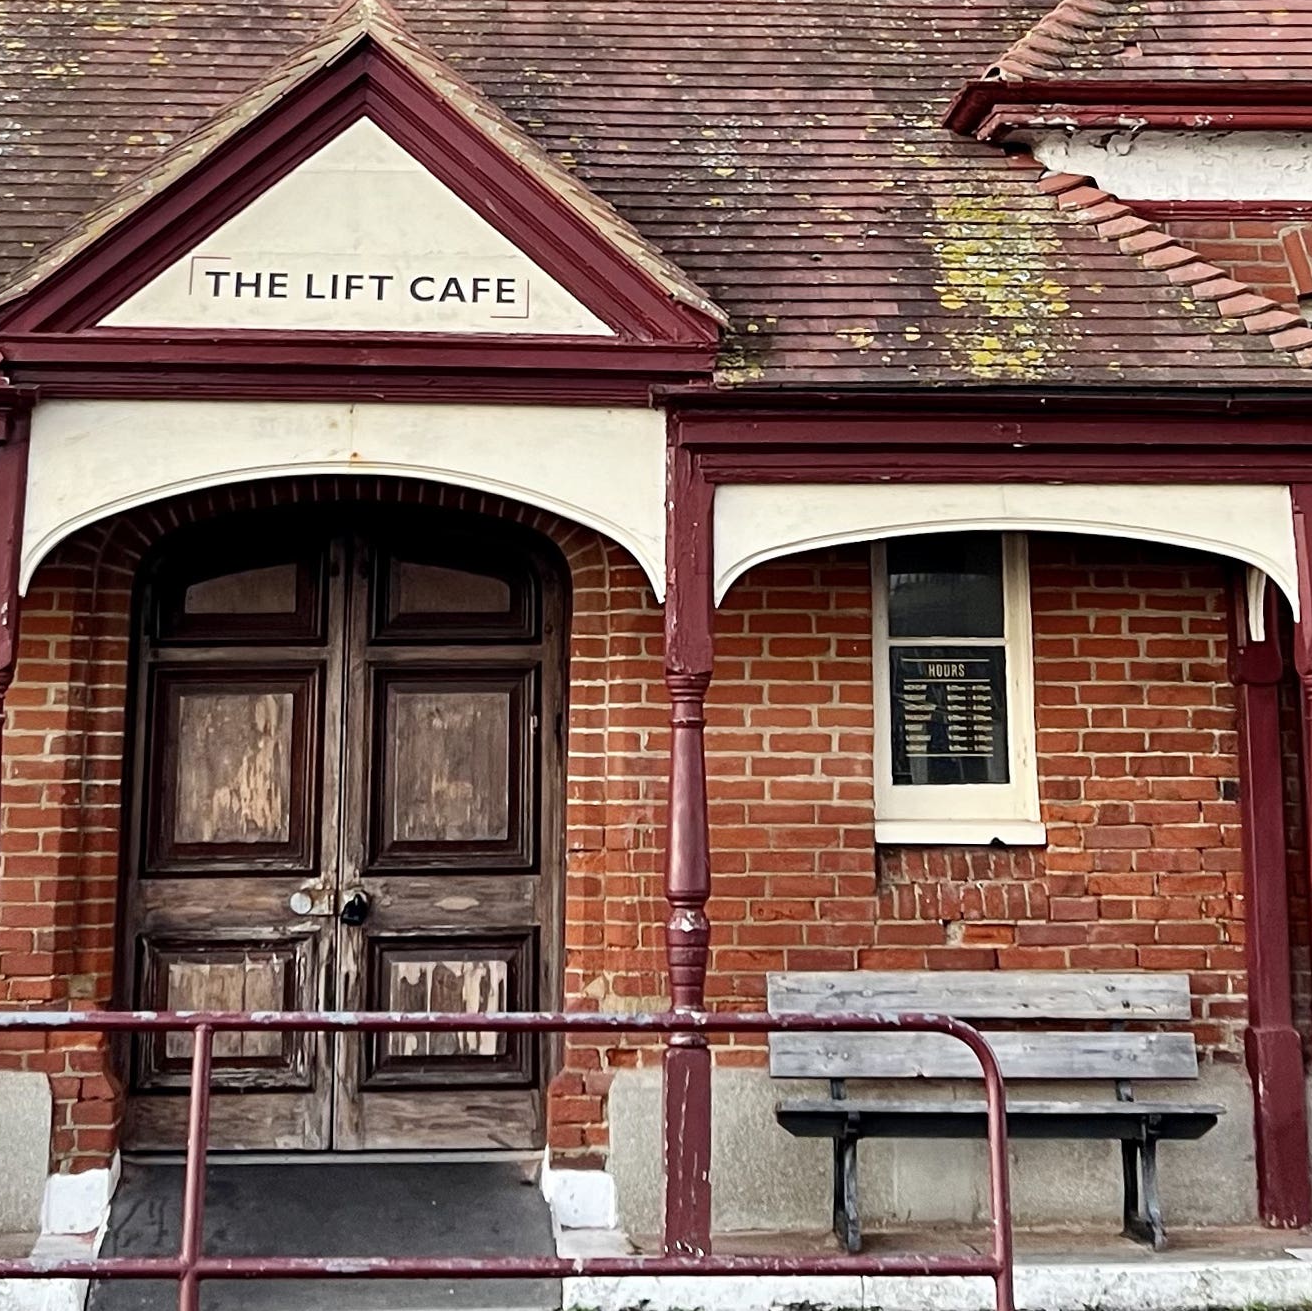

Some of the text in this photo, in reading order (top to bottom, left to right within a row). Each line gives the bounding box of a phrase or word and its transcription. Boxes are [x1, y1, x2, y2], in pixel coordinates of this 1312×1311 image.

[205, 270, 516, 304] THE LIFT CAFE
[928, 663, 966, 678] HOURS
